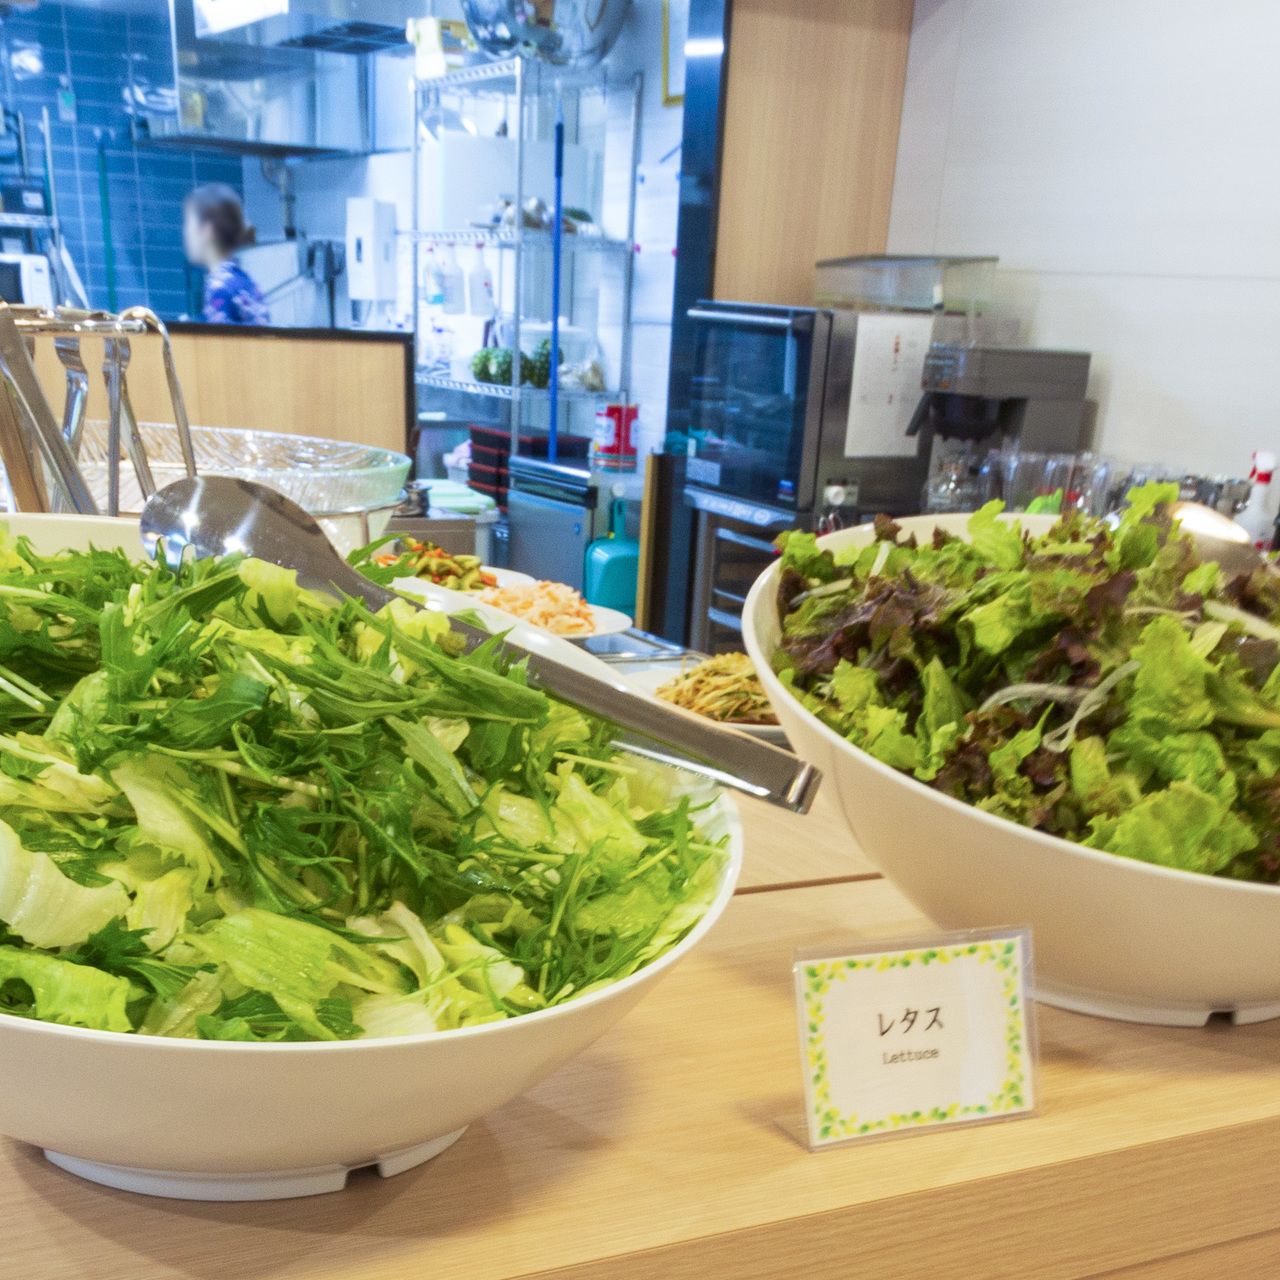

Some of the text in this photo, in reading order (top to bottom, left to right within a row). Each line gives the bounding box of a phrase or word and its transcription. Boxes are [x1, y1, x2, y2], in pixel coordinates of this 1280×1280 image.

[879, 1007, 944, 1037] レタス
[883, 1048, 940, 1065] Lettuce
